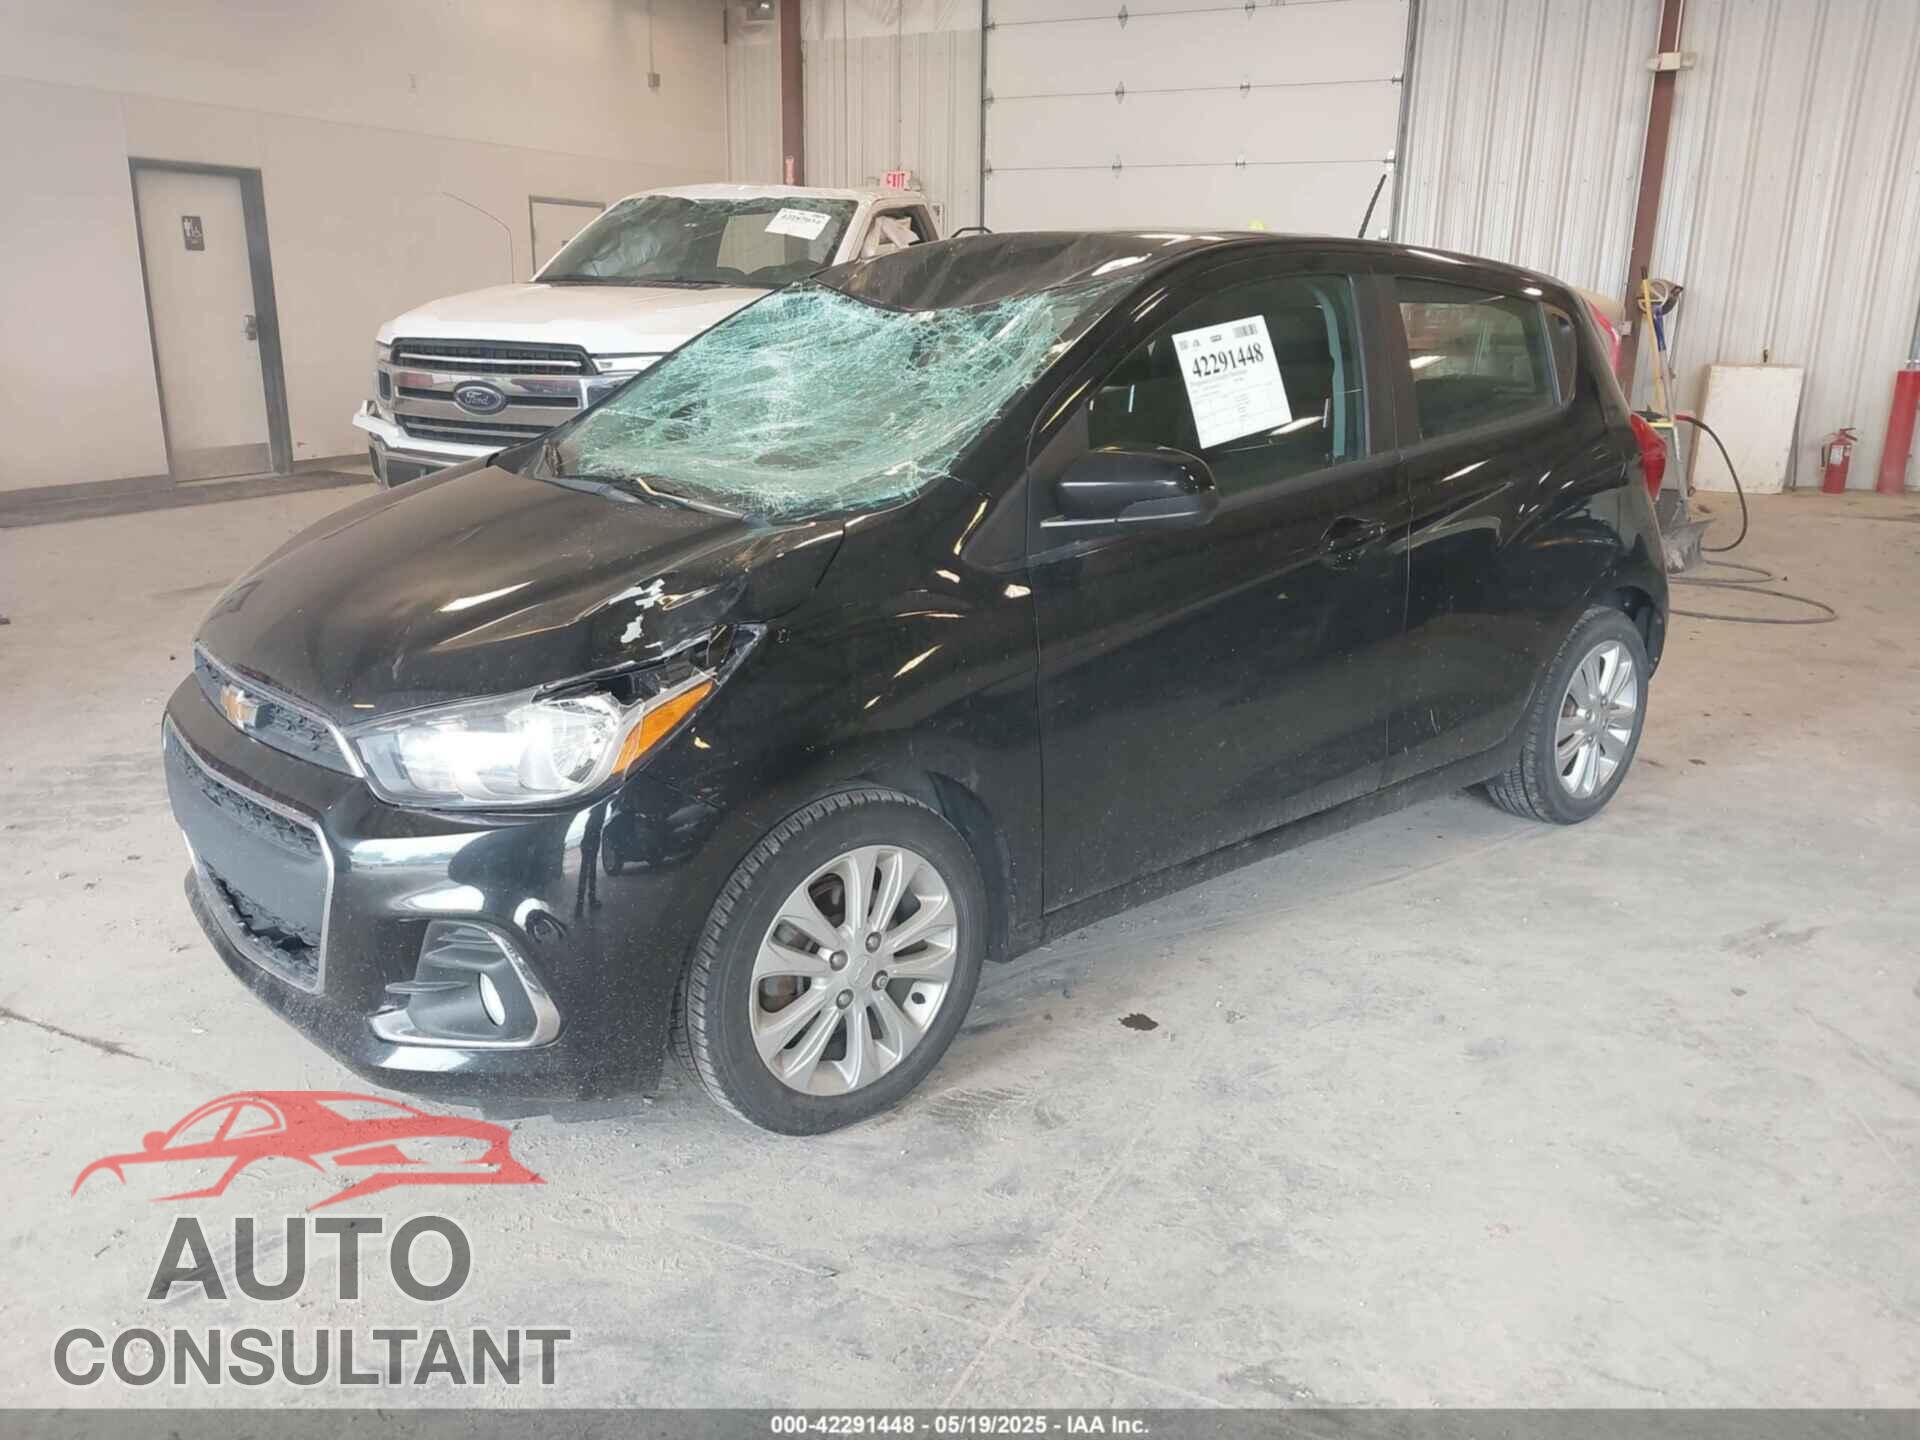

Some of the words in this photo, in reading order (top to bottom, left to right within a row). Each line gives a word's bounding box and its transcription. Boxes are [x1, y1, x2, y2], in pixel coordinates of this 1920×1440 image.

[886, 172, 905, 188] EXIT
[1192, 342, 1265, 377] 42291448
[464, 390, 489, 405] Ford
